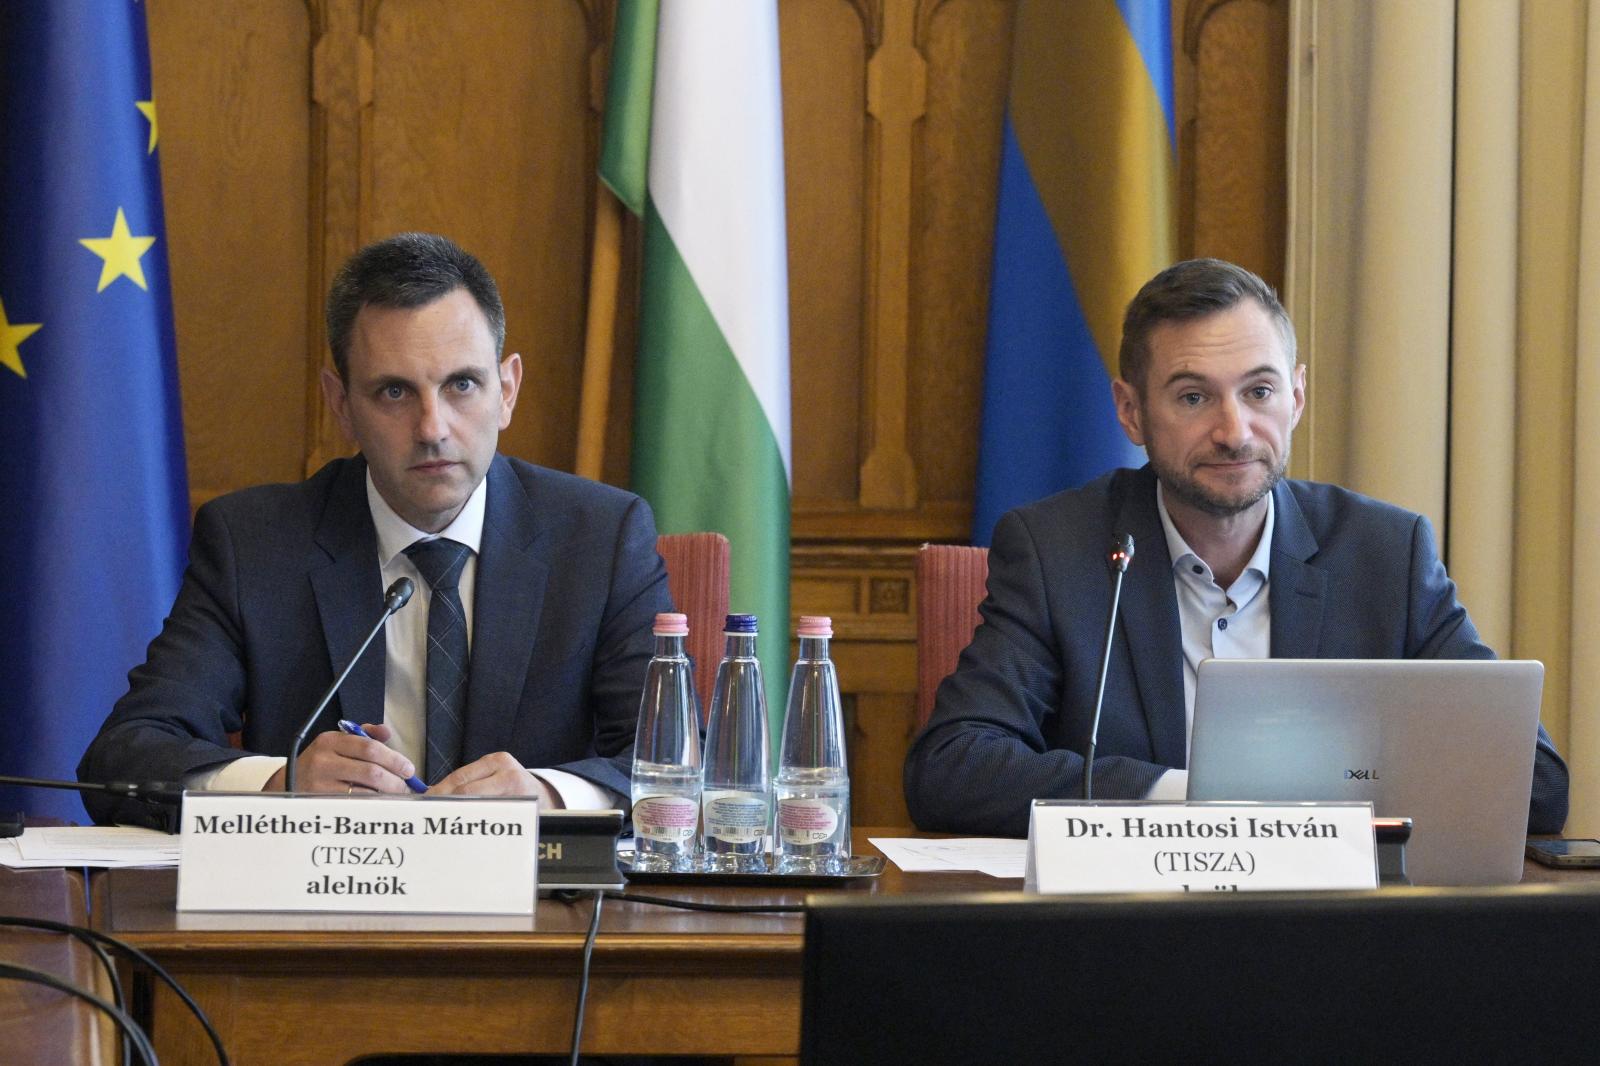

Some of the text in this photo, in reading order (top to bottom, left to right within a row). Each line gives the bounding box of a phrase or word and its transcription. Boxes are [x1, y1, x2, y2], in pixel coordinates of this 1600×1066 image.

[1343, 769, 1380, 781] DELL
[194, 814, 523, 837] Melléthei-Barna Márton
[1065, 816, 1339, 839] Dr. Hantosi István
[310, 845, 405, 869] (TISZA)
[1153, 851, 1256, 876] (TISZA)
[306, 876, 407, 896] alelnök
